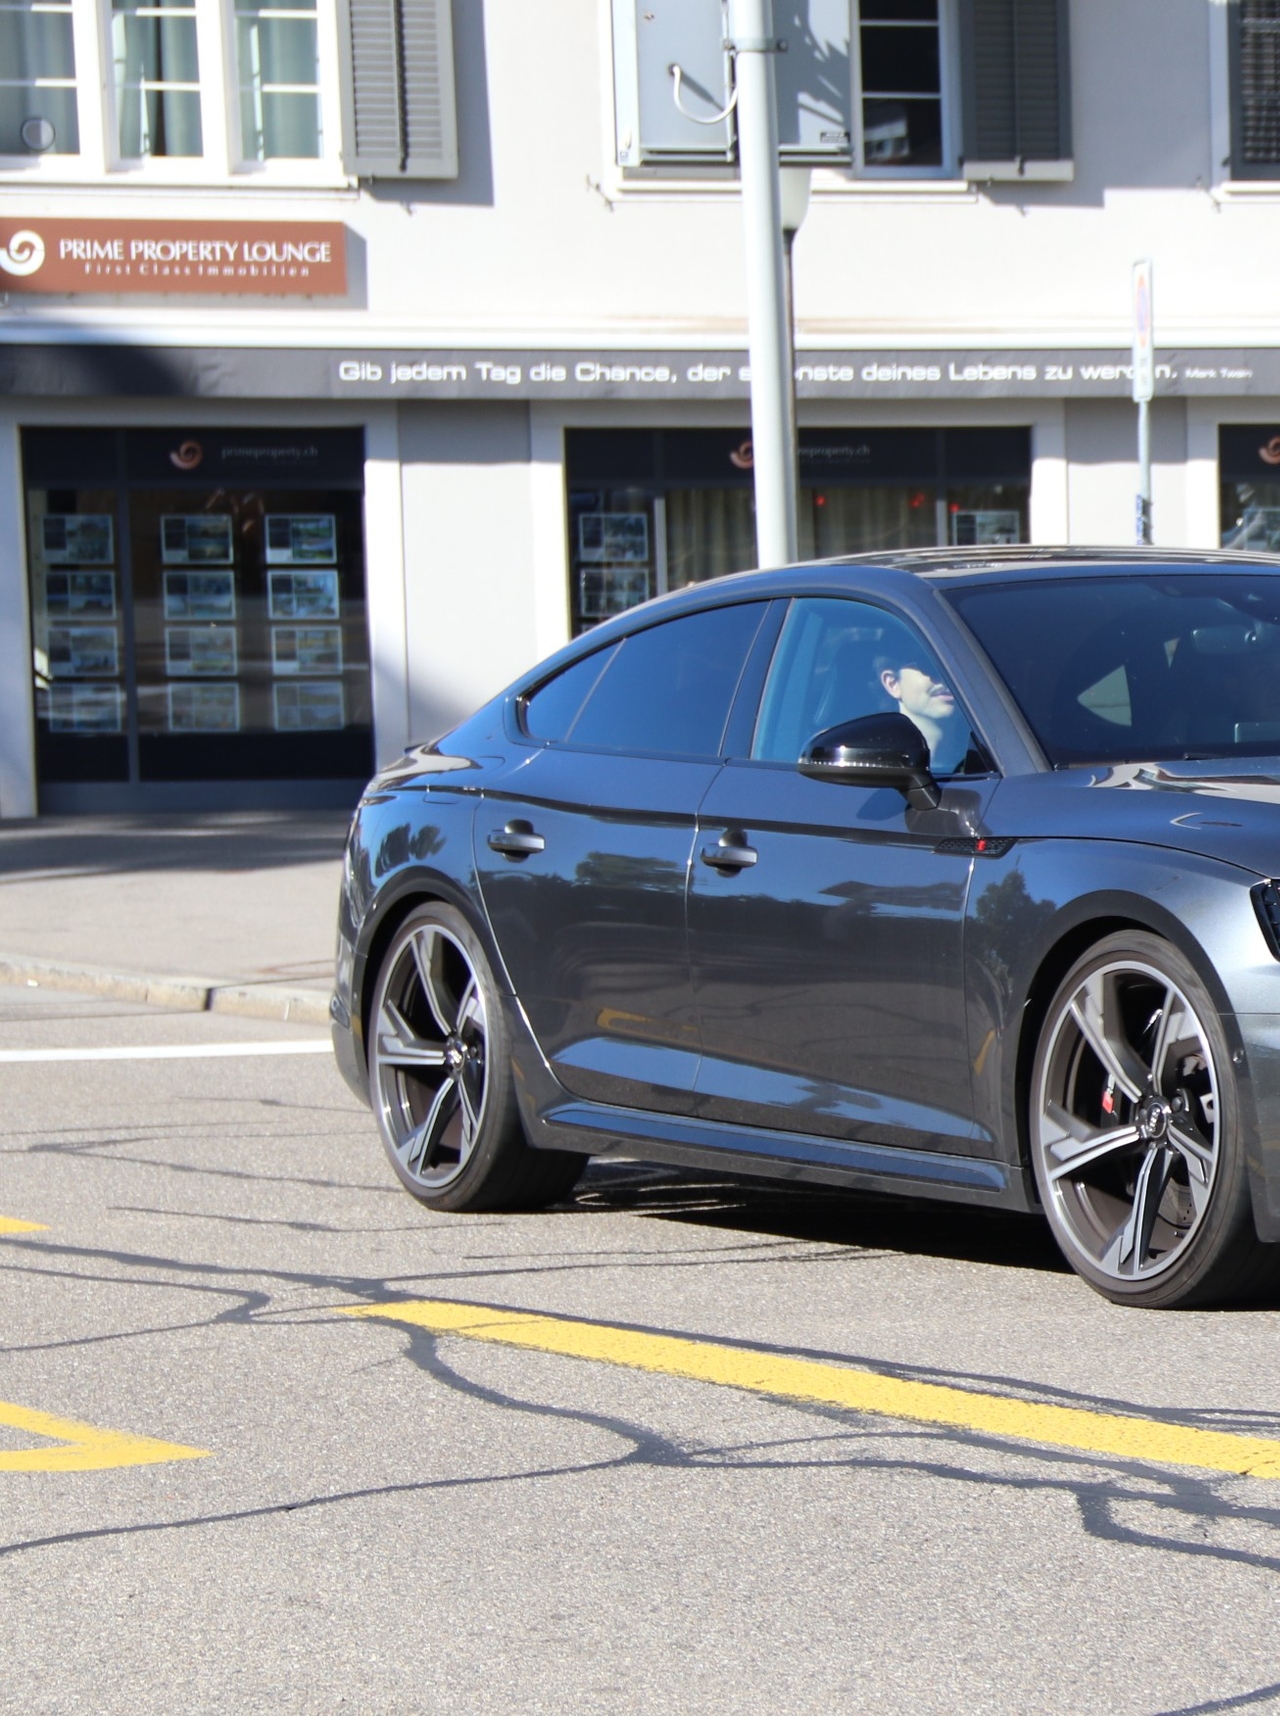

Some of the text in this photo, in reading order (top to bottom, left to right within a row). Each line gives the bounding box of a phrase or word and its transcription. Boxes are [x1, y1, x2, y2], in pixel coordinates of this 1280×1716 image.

[59, 239, 331, 263] PRIME PROPERTY LOUNGE
[84, 262, 309, 277] First Class Immobilien
[338, 361, 382, 381] Gib
[389, 361, 467, 384] jedem
[474, 361, 521, 384] Tag
[529, 361, 566, 381] die
[574, 362, 677, 384] Chance,
[687, 362, 731, 382] der
[861, 362, 941, 381] deines
[948, 361, 1037, 381] Lebens
[1044, 364, 1073, 381] zu
